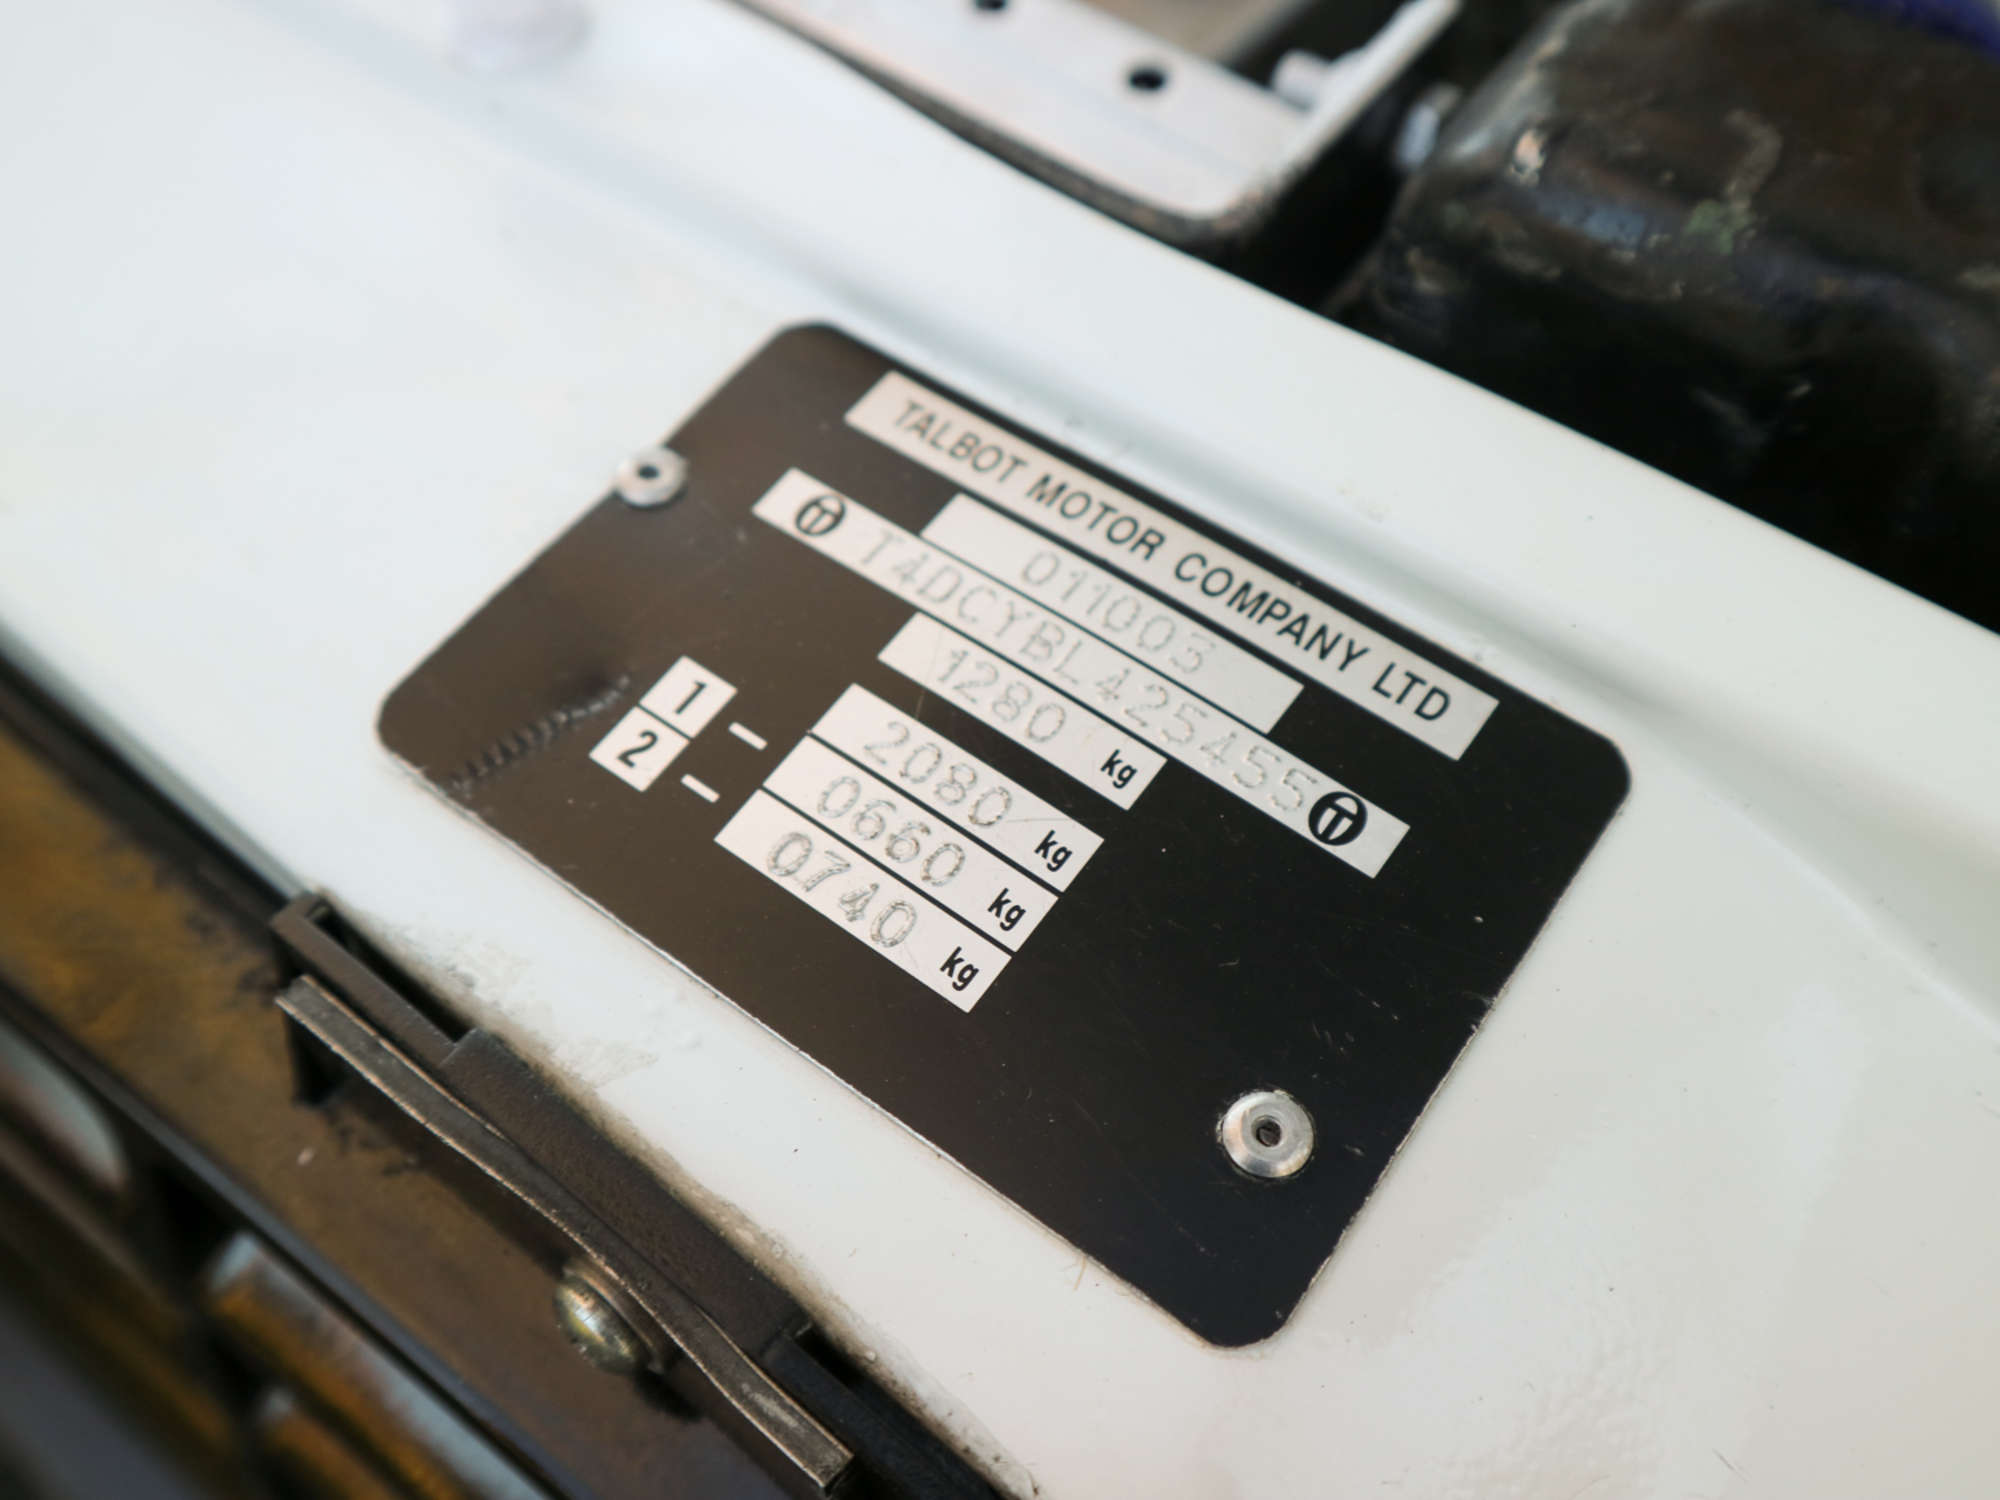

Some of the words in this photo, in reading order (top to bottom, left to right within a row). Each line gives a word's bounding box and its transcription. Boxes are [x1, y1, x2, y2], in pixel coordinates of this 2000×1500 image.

[894, 401, 1029, 484] TALBOT
[1025, 474, 1166, 560] MOTOR
[1174, 552, 1371, 672] COMPANY
[1371, 662, 1451, 721] LTD
[675, 681, 706, 714] 1
[816, 775, 966, 887] 0660
[987, 888, 1027, 932] kg
[863, 719, 1013, 827] 2080
[1034, 831, 1073, 872] kg
[937, 647, 1067, 744] 1280
[1100, 749, 1138, 788] kg
[617, 730, 658, 768] 2
[766, 831, 918, 948] 0740
[940, 947, 980, 992] kg
